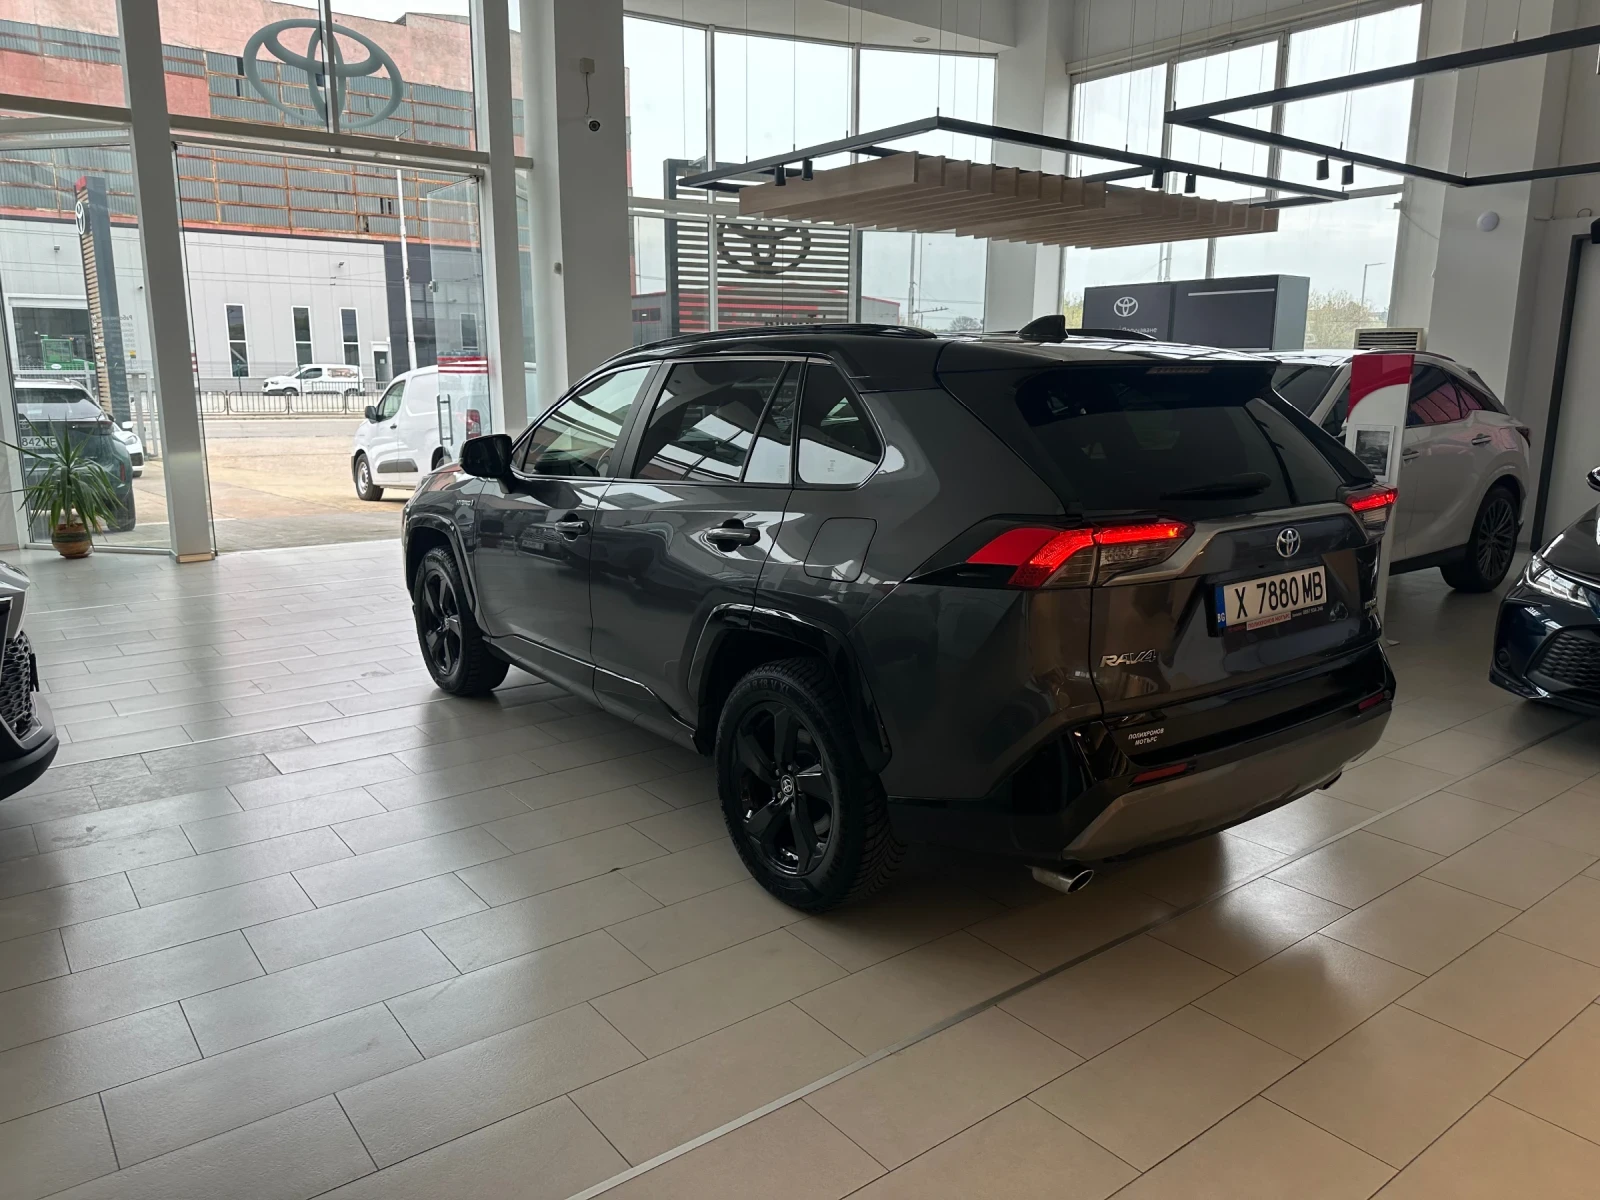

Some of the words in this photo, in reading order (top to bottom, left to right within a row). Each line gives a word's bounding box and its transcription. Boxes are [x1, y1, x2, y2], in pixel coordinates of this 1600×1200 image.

[1235, 586, 1248, 619] X
[1256, 576, 1298, 614] 7880
[1302, 572, 1323, 604] MB
[1217, 612, 1226, 622] BG
[1100, 649, 1156, 667] RAV4
